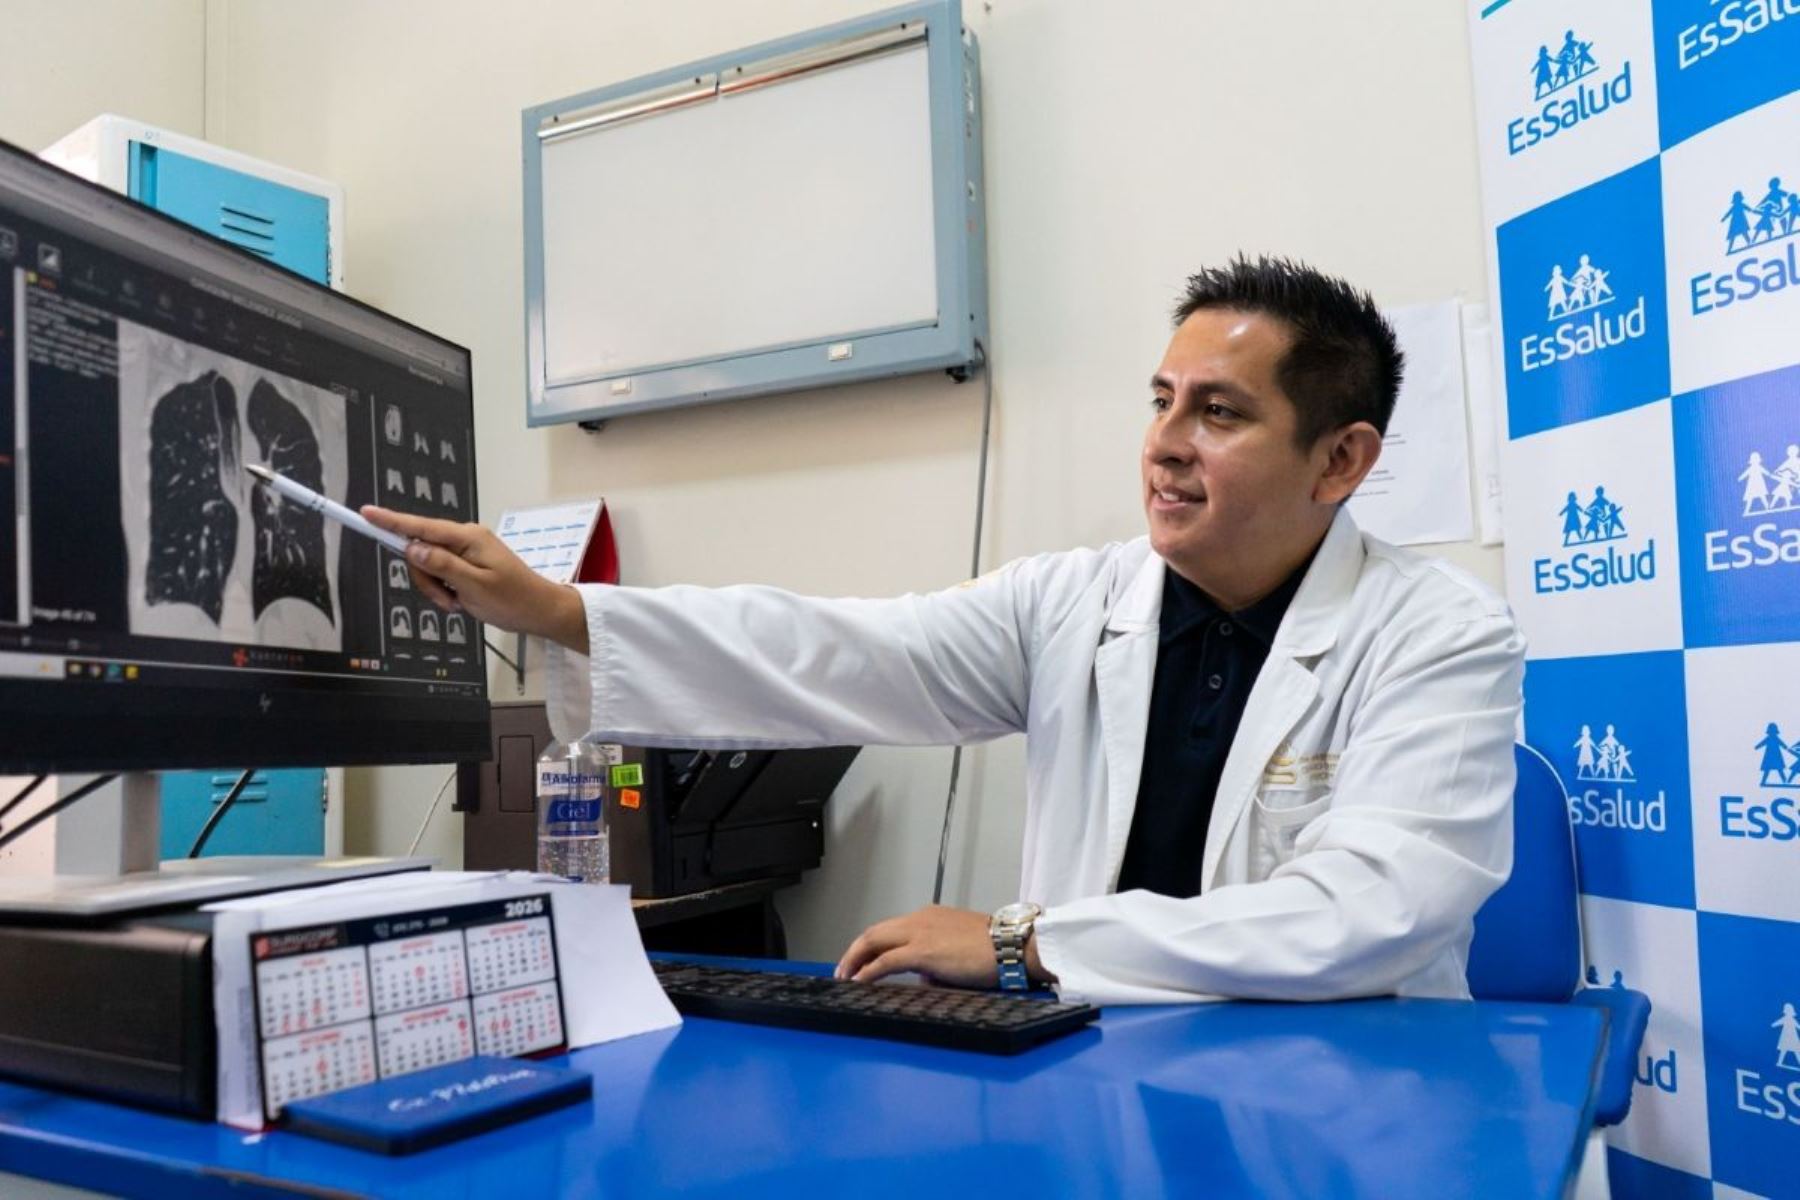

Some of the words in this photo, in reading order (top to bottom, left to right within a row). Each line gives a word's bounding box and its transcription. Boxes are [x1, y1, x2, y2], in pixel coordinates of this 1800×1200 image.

[1508, 62, 1632, 155] EsSalud
[1521, 297, 1645, 372] EsSalud
[1535, 539, 1655, 594] EsSalud
[1568, 788, 1667, 832] sSalud
[1719, 796, 1800, 841] EsS
[505, 897, 543, 918] 2026
